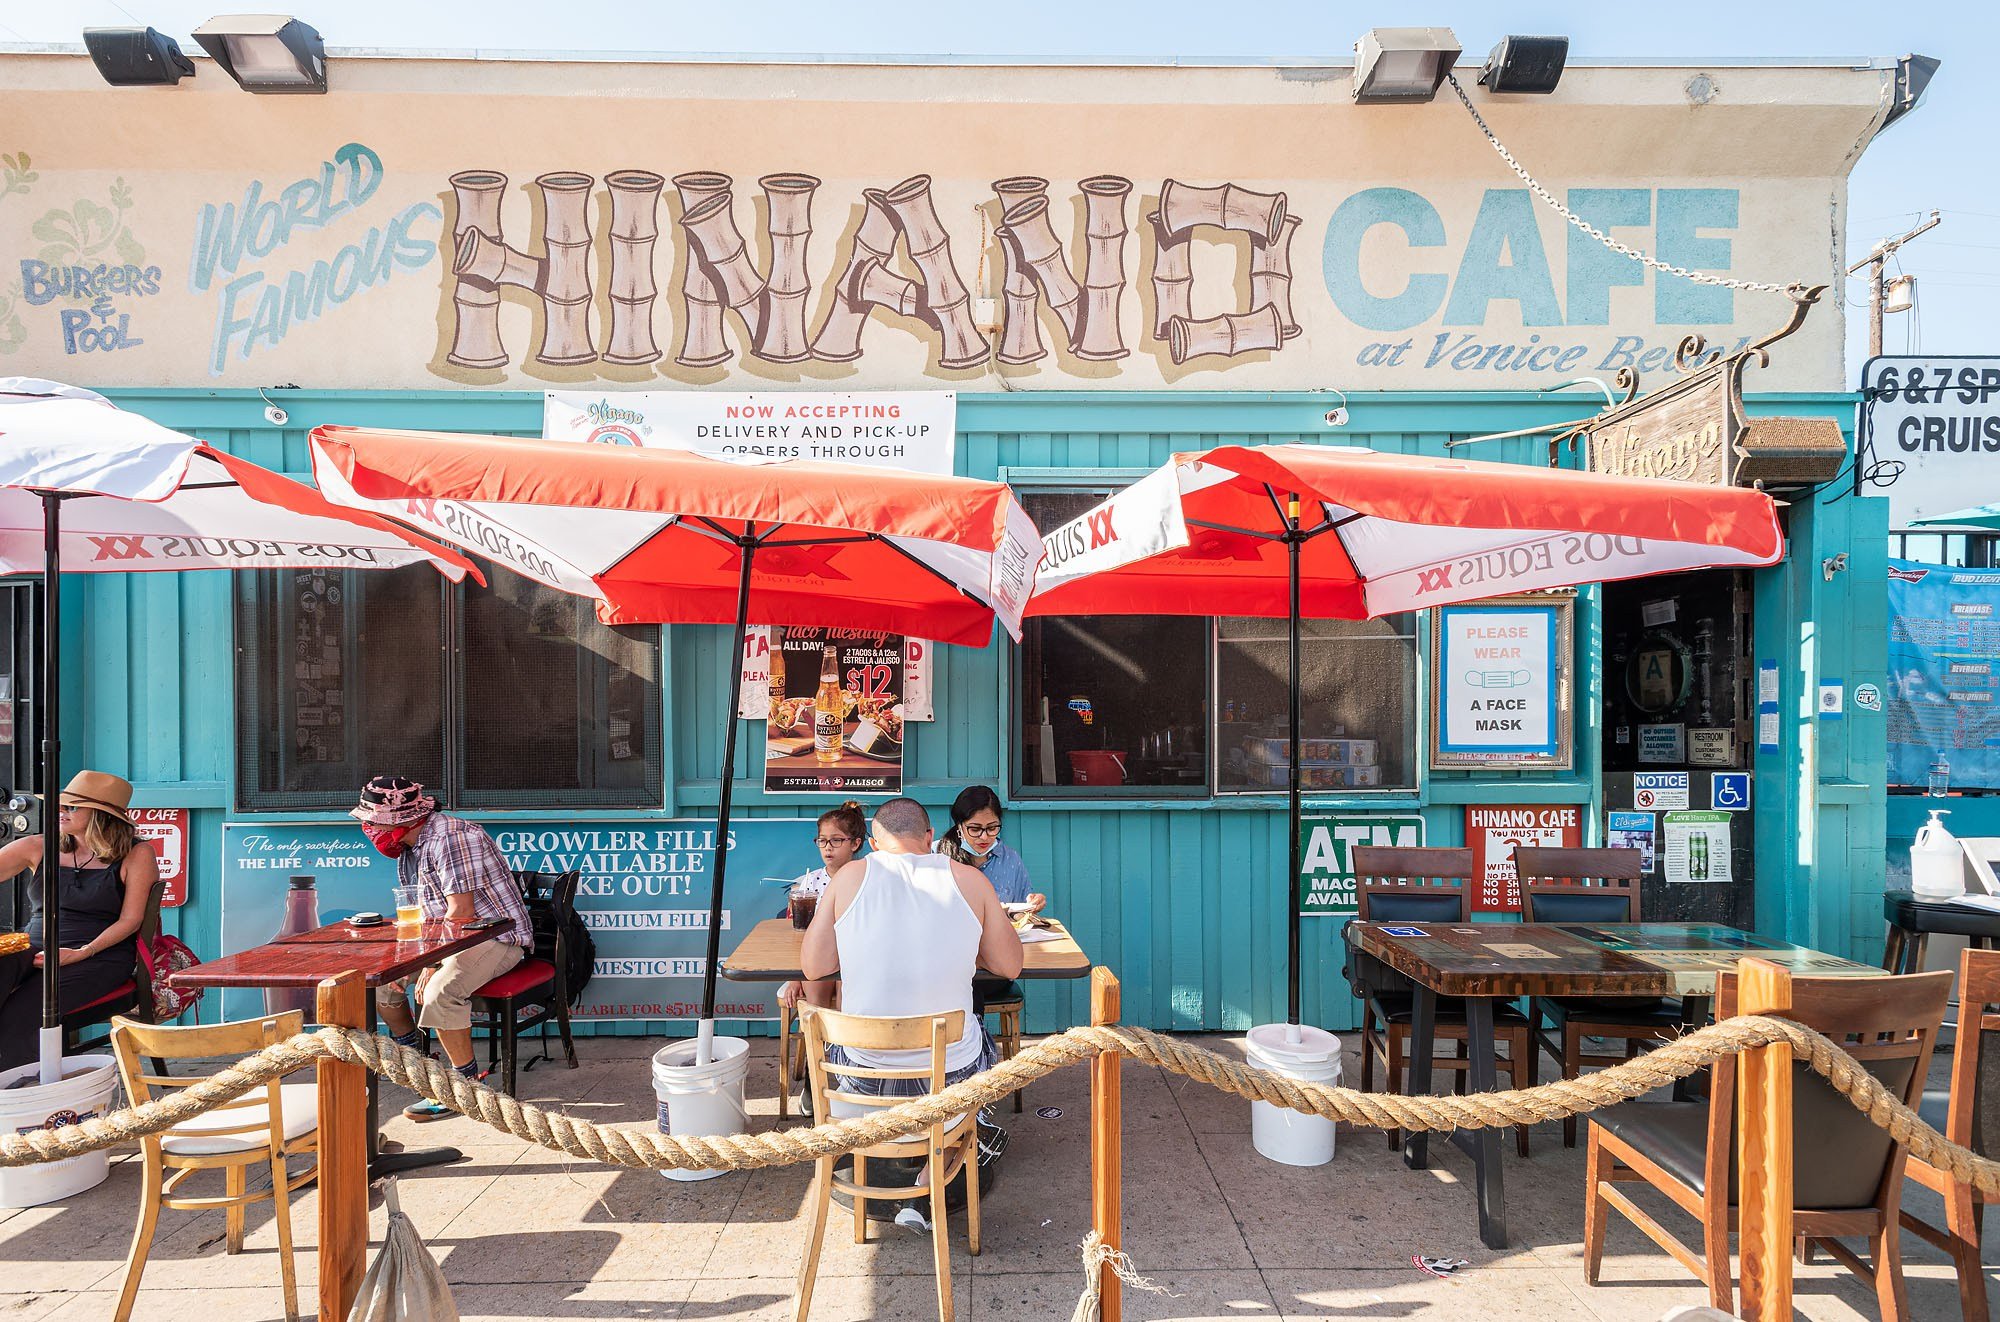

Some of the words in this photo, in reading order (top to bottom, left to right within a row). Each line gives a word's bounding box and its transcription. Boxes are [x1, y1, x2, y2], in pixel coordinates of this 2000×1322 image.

[189, 142, 384, 294] WORLD
[1322, 187, 1741, 332] CAFE
[446, 168, 1303, 370] HINANO
[209, 202, 443, 377] FAMOUS
[60, 308, 144, 355] POOL
[1356, 338, 1413, 367] at
[1424, 332, 1588, 373] Venice
[726, 406, 774, 418] NOW
[785, 405, 901, 418] ACCEPTING
[697, 425, 790, 438] DELIVERY
[801, 426, 842, 438] AND
[853, 425, 930, 438] PICK-UP
[810, 445, 904, 458] THROUGH
[1466, 627, 1528, 639] PLEASE
[783, 641, 799, 651] ALL
[802, 641, 824, 651] DAY!
[846, 648, 851, 656] 2
[852, 648, 872, 656] TACOS
[1474, 647, 1521, 659] WEAR
[843, 656, 873, 664] ESTRELLA
[846, 664, 892, 699] $12
[1470, 699, 1482, 711] A
[1486, 699, 1527, 710] FACE
[1475, 719, 1522, 731] MASK
[1695, 732, 1723, 741] RESTROOM
[1636, 776, 1687, 787] NOTICE
[146, 809, 179, 820] CAFE
[1471, 809, 1535, 828] HINANO
[1539, 809, 1576, 827] CAFE
[1510, 830, 1538, 838] MUST
[242, 835, 275, 854] The
[276, 839, 303, 857] only
[305, 839, 350, 854] sacrifice
[350, 840, 367, 850] in
[495, 831, 649, 852] GROWLER
[238, 858, 267, 869] THE
[270, 857, 302, 869] LIFE
[314, 856, 370, 868] ARTOIS
[538, 853, 704, 873] AVAILABLE
[621, 875, 691, 896] OUT!
[1483, 897, 1498, 905] NO
[672, 960, 726, 975] FILS
[632, 1004, 661, 1016] FOR
[684, 1004, 765, 1017] PUCHASE
